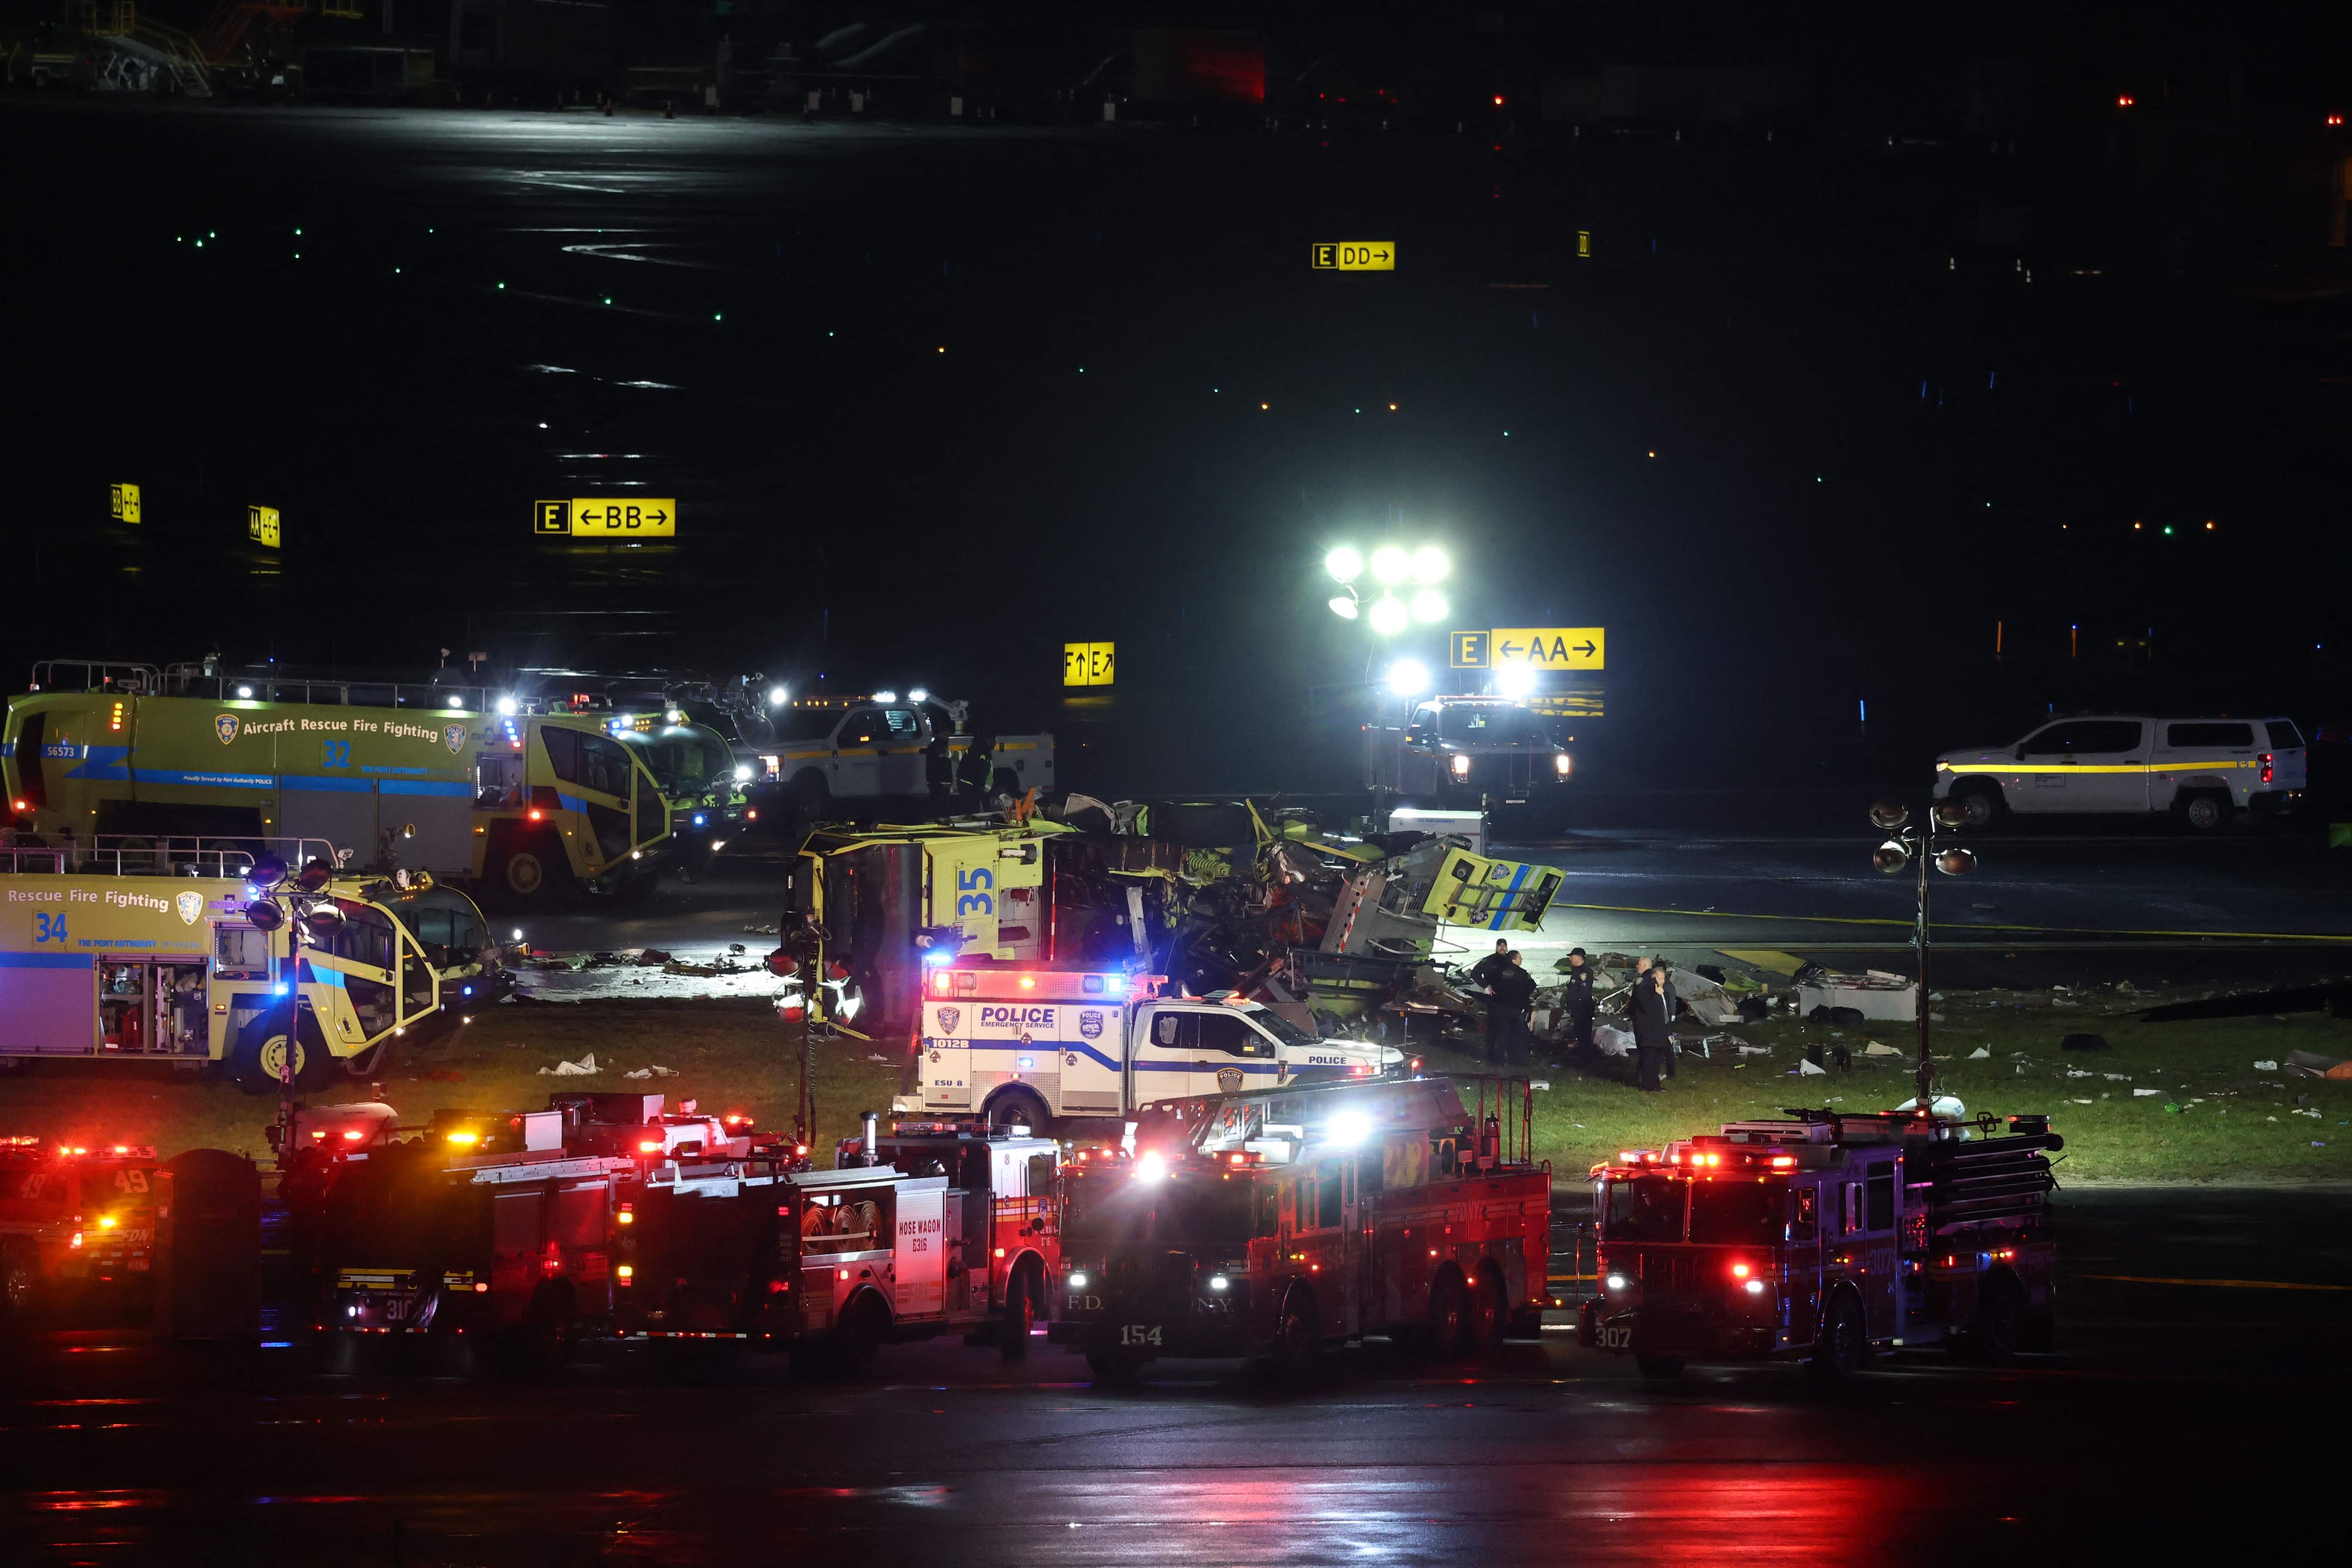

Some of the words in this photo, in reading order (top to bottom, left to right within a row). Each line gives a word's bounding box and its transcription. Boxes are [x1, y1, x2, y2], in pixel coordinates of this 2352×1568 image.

[1319, 247, 1331, 265] E
[1344, 248, 1370, 264] DD
[113, 489, 121, 513] BB
[251, 511, 260, 536] AA
[545, 505, 560, 529] E
[606, 506, 641, 529] BB
[1462, 636, 1478, 663] E
[1527, 636, 1569, 662] AA
[1065, 652, 1073, 677] F
[1092, 651, 1100, 677] E
[243, 719, 295, 735] Aircraft
[301, 719, 348, 730] Rescue
[354, 719, 378, 732] Fire
[384, 722, 438, 743] Fighting
[48, 747, 74, 757] 56573
[323, 740, 351, 768] 32
[8, 890, 62, 902] Rescue
[70, 889, 98, 902] Fire
[105, 891, 169, 913] Fighting
[958, 868, 993, 916] 35
[36, 912, 68, 943] 34
[981, 1007, 1054, 1023] POLICE
[932, 1039, 969, 1048] 1012B
[1309, 1056, 1346, 1064] POLICE
[114, 1170, 149, 1194] 49
[120, 1229, 153, 1242] FDN
[899, 1221, 915, 1235] HOSE
[918, 1219, 940, 1234] WAGON
[913, 1238, 927, 1252] E316
[1067, 1295, 1104, 1310] F.D.
[1198, 1298, 1234, 1313] NY.
[1121, 1324, 1162, 1345] 154
[1596, 1327, 1631, 1348] 307
